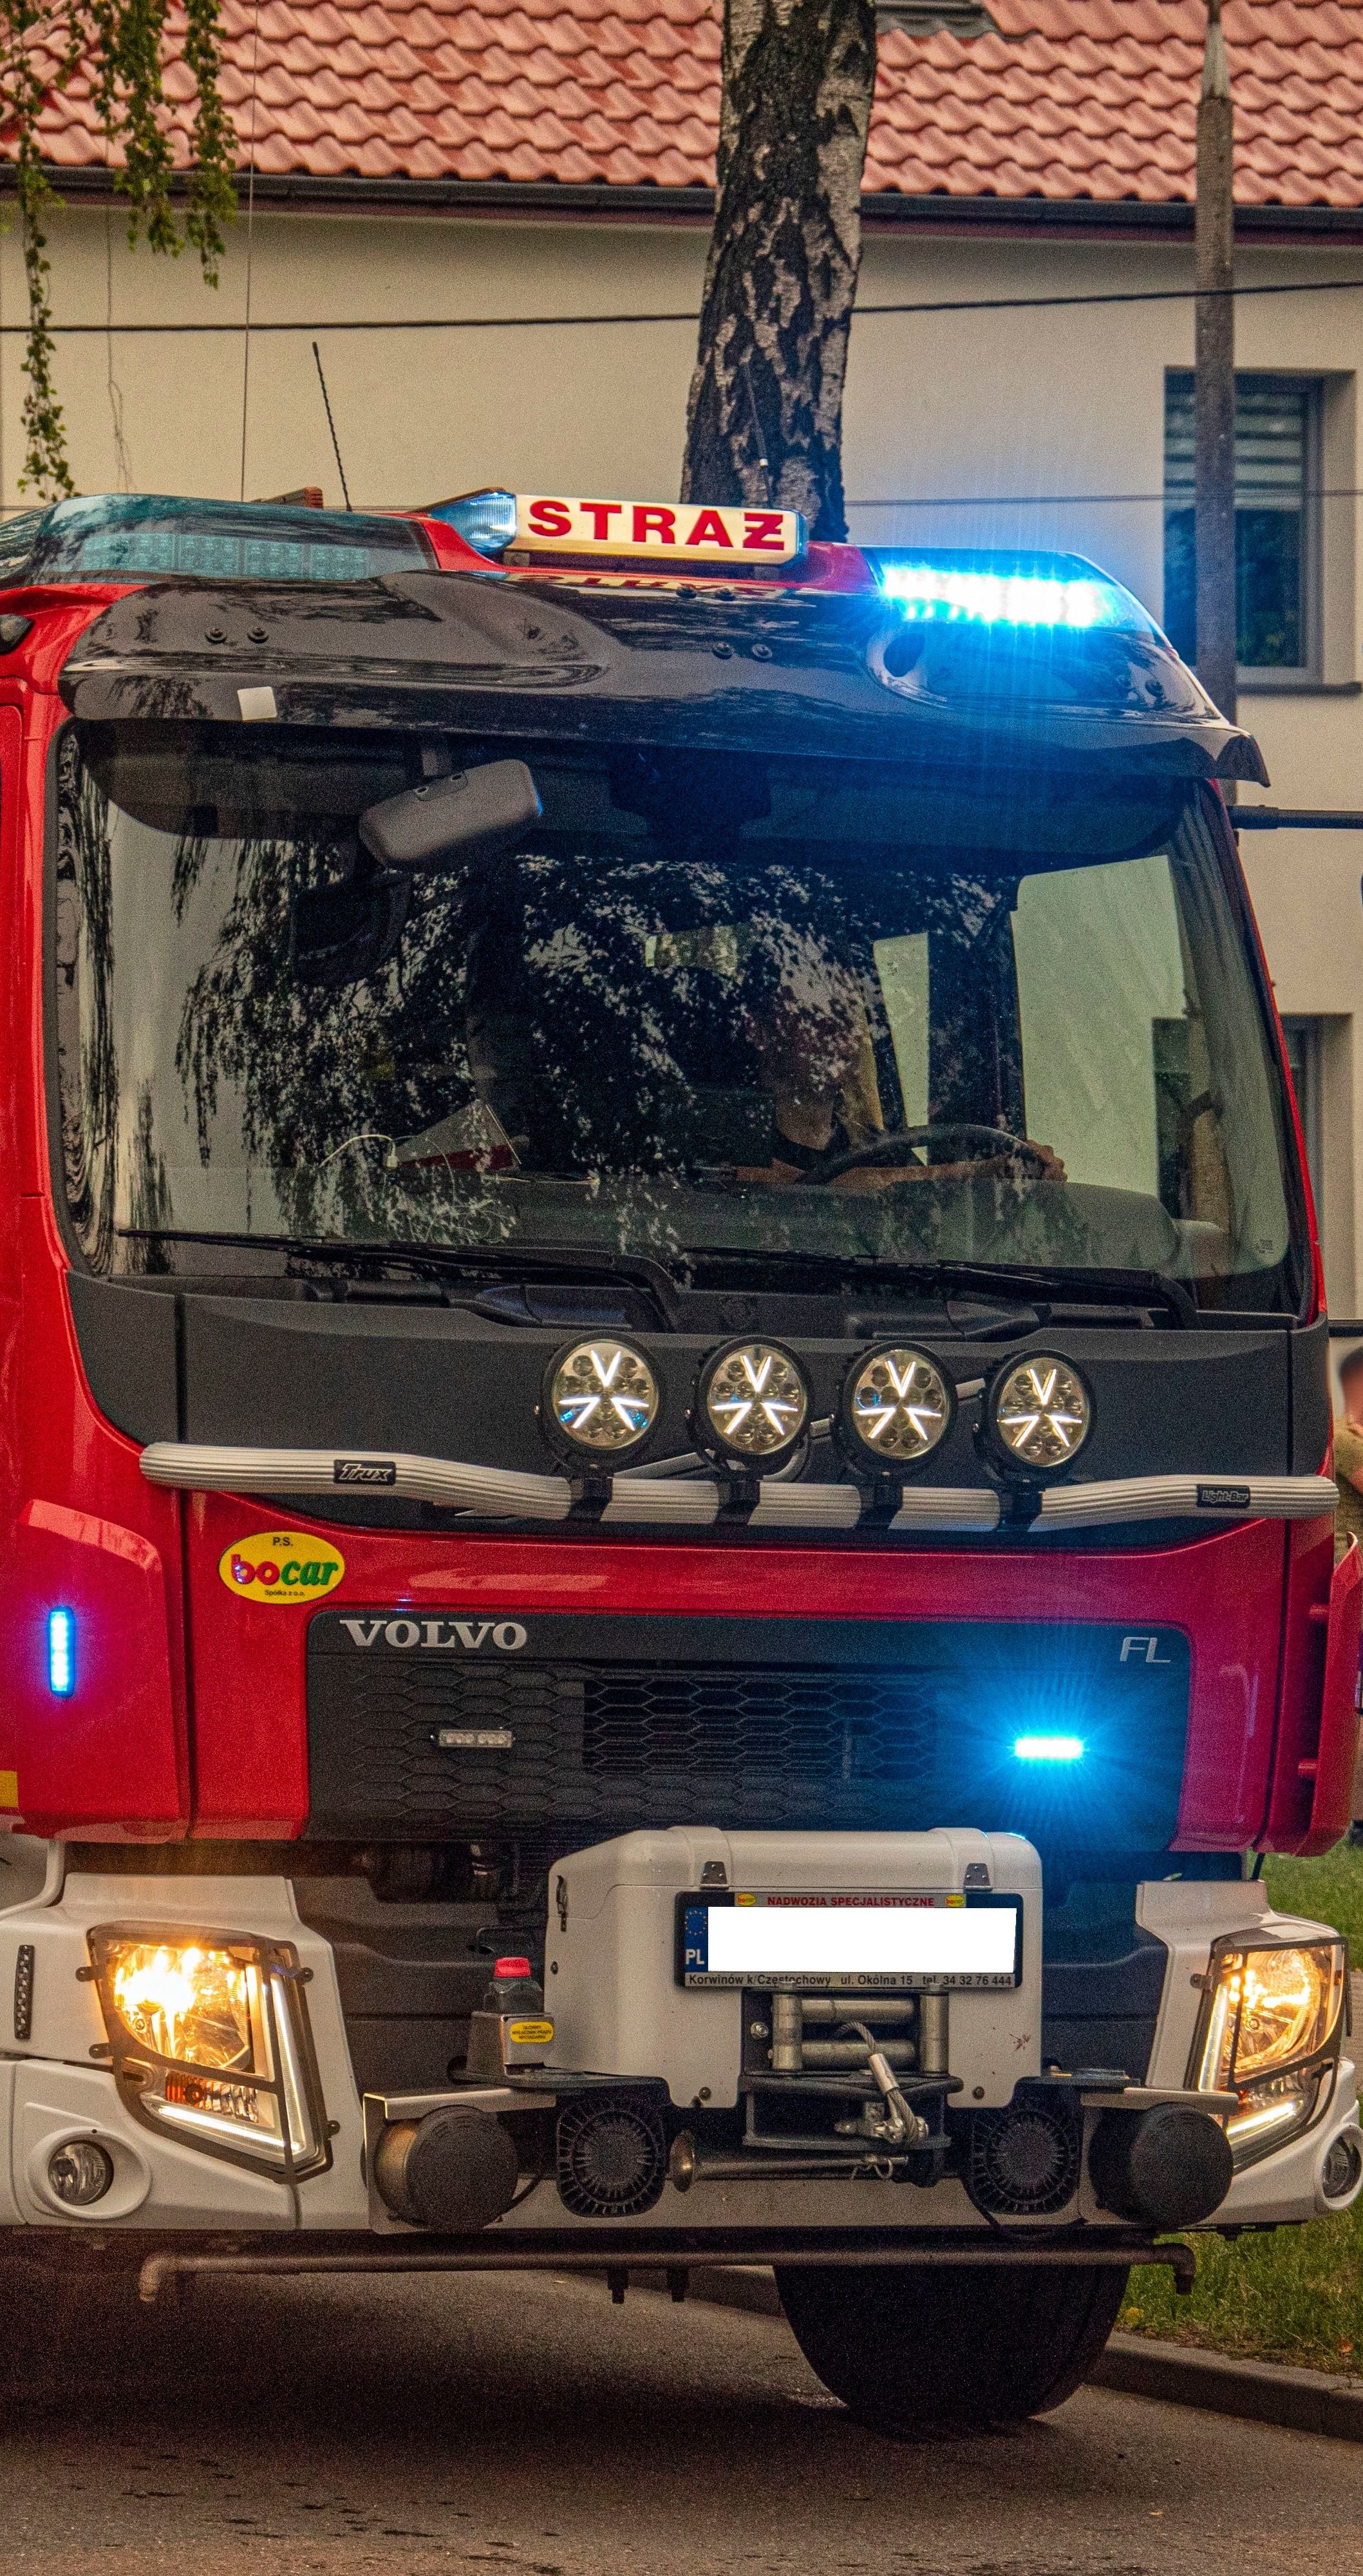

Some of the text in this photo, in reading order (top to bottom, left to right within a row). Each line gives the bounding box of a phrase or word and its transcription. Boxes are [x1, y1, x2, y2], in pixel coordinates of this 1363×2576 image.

[338, 1463, 393, 1481] Trux
[1201, 1490, 1249, 1504] Light-Bar
[272, 1537, 294, 1547] P.S.
[230, 1553, 339, 1586] bocar
[339, 1619, 527, 1651] VOLVO
[1119, 1636, 1172, 1664] FL
[767, 1897, 934, 1908] NADWOZIA SPECJALISTYCZNE
[685, 1948, 705, 1965] PL
[689, 1973, 744, 1985] Korwinów
[840, 1975, 854, 1985] ul.
[858, 1974, 896, 1985] Okólna
[901, 1975, 913, 1985] 15
[943, 1975, 955, 1985] 34
[959, 1975, 972, 1985] 32
[976, 1975, 988, 1985] 76
[992, 1976, 1011, 1986] 444
